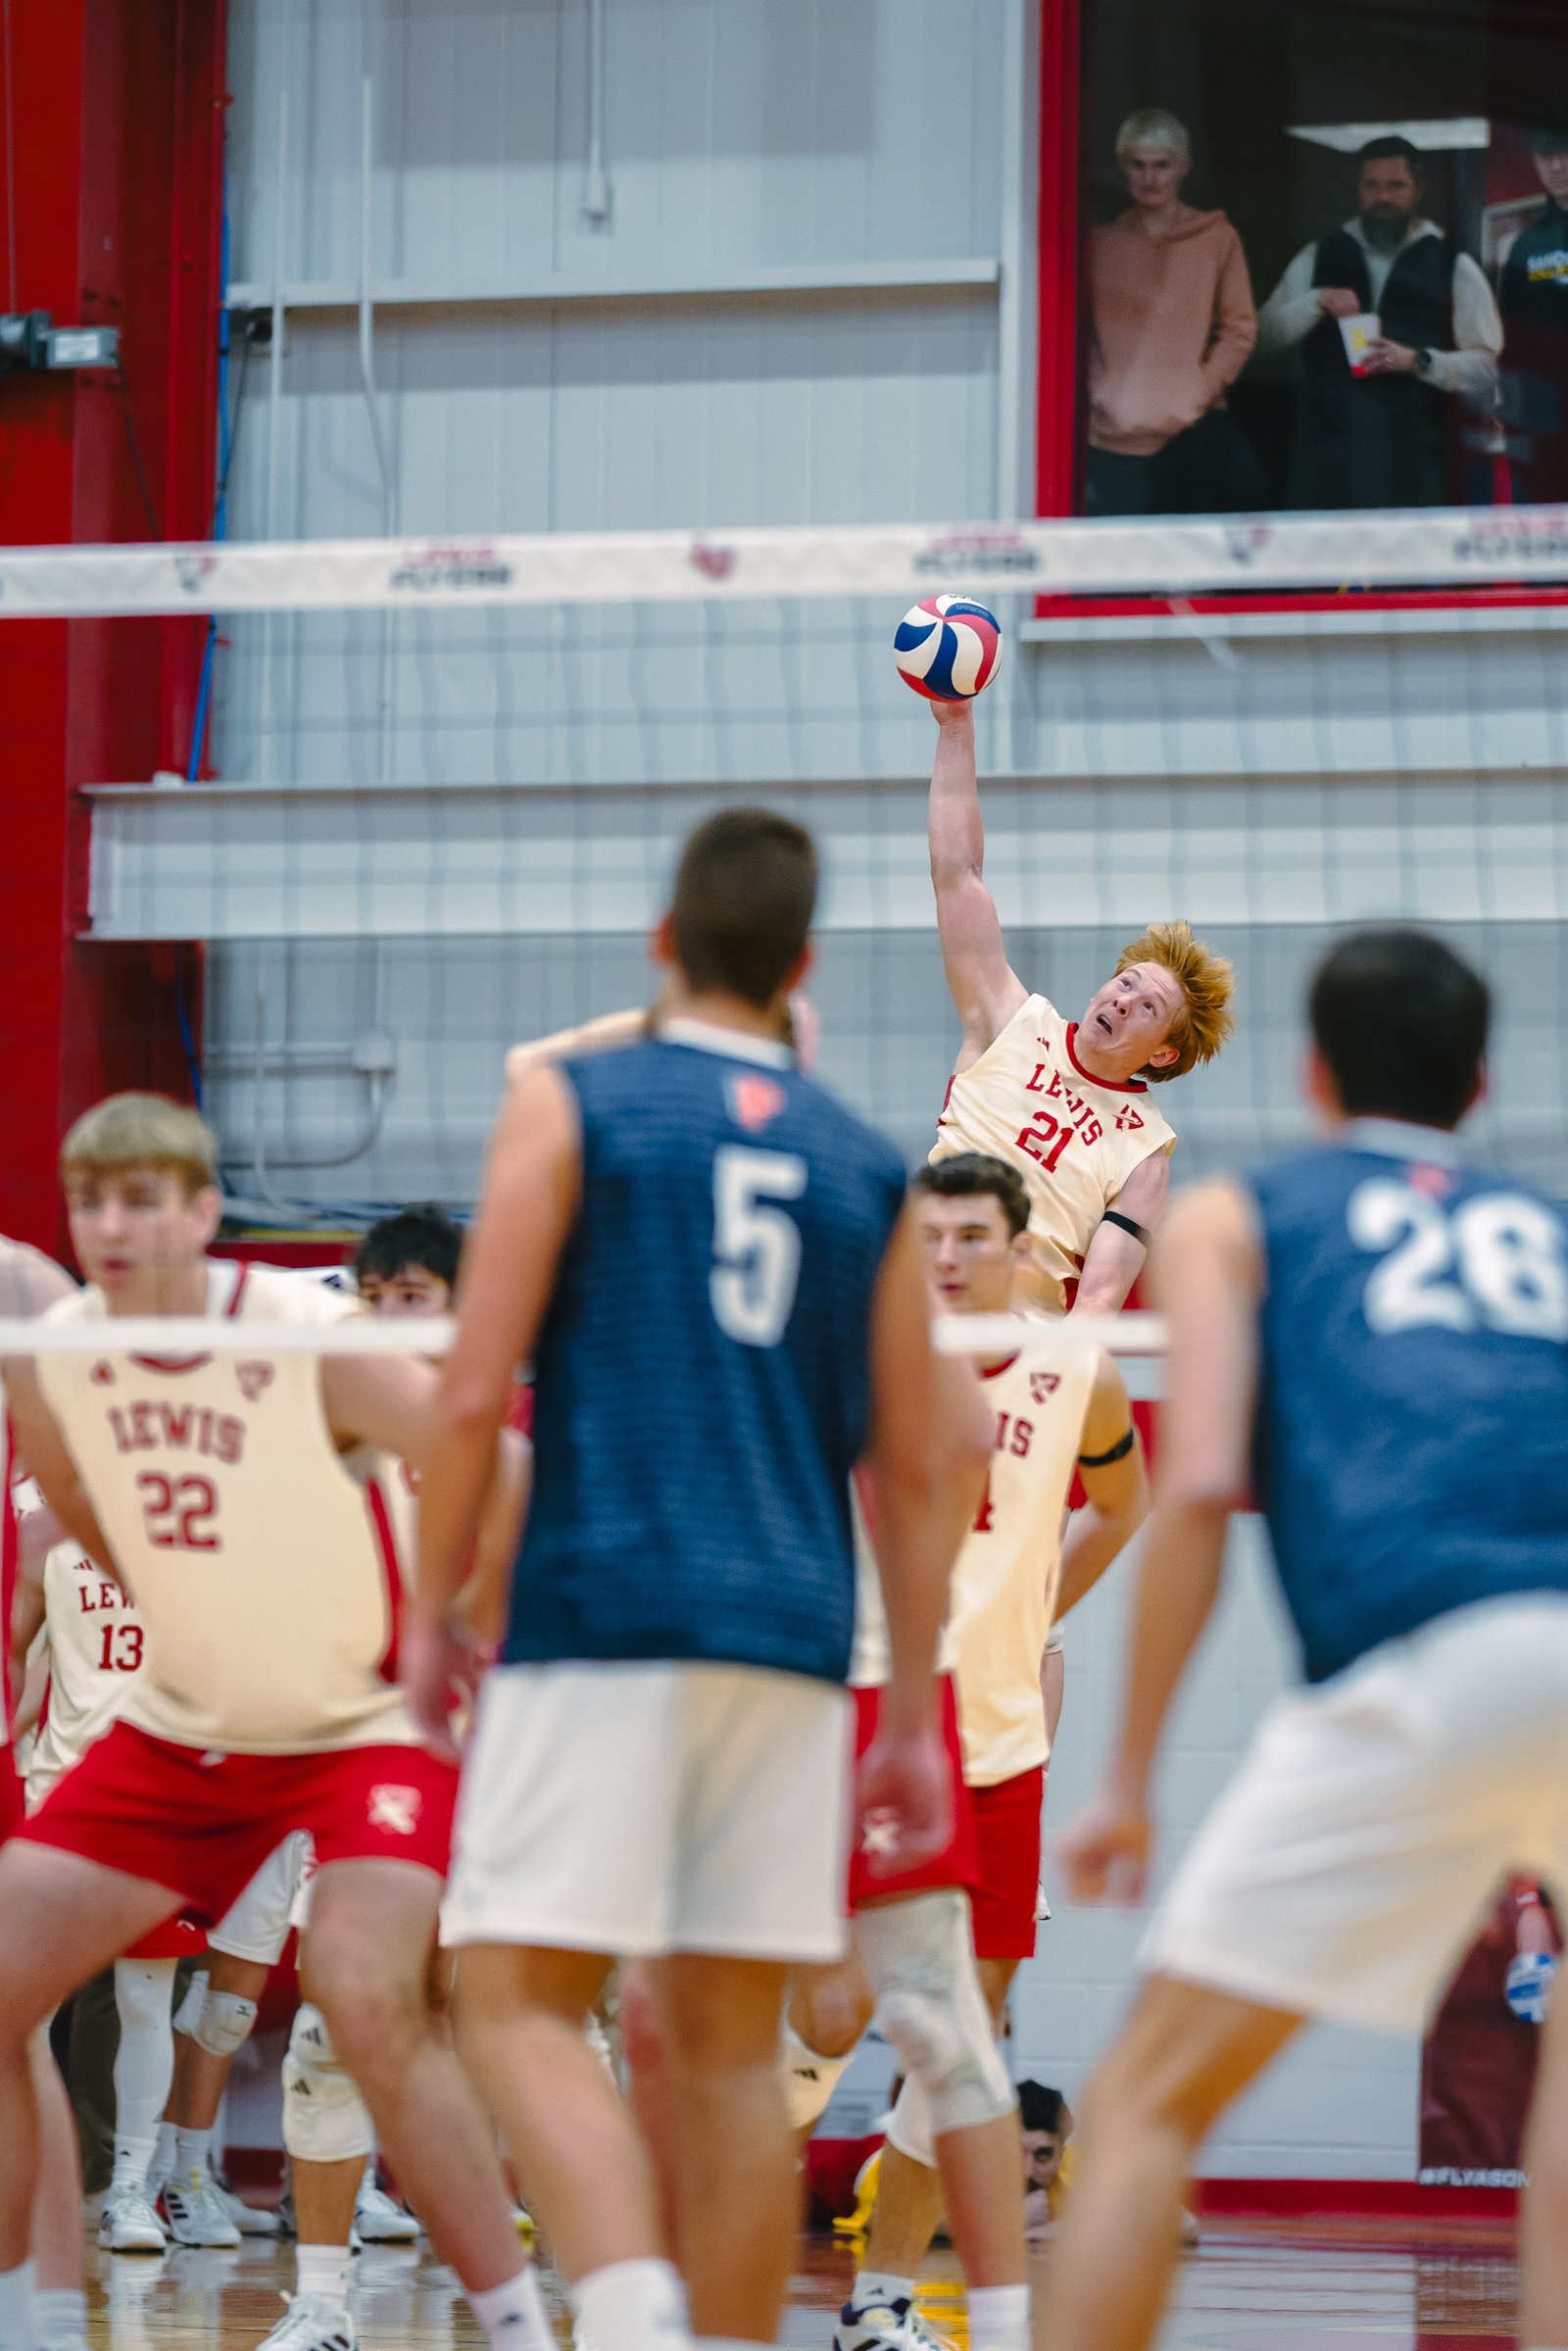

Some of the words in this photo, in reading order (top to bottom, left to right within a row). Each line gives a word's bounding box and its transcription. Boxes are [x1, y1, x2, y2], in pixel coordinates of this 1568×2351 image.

[1025, 1063, 1103, 1146] LEWIS
[1014, 1110, 1074, 1174] 21
[710, 1145, 808, 1348] 5
[108, 1400, 246, 1464] LEWIS
[137, 1471, 221, 1551] 22
[98, 1624, 144, 1672] 13
